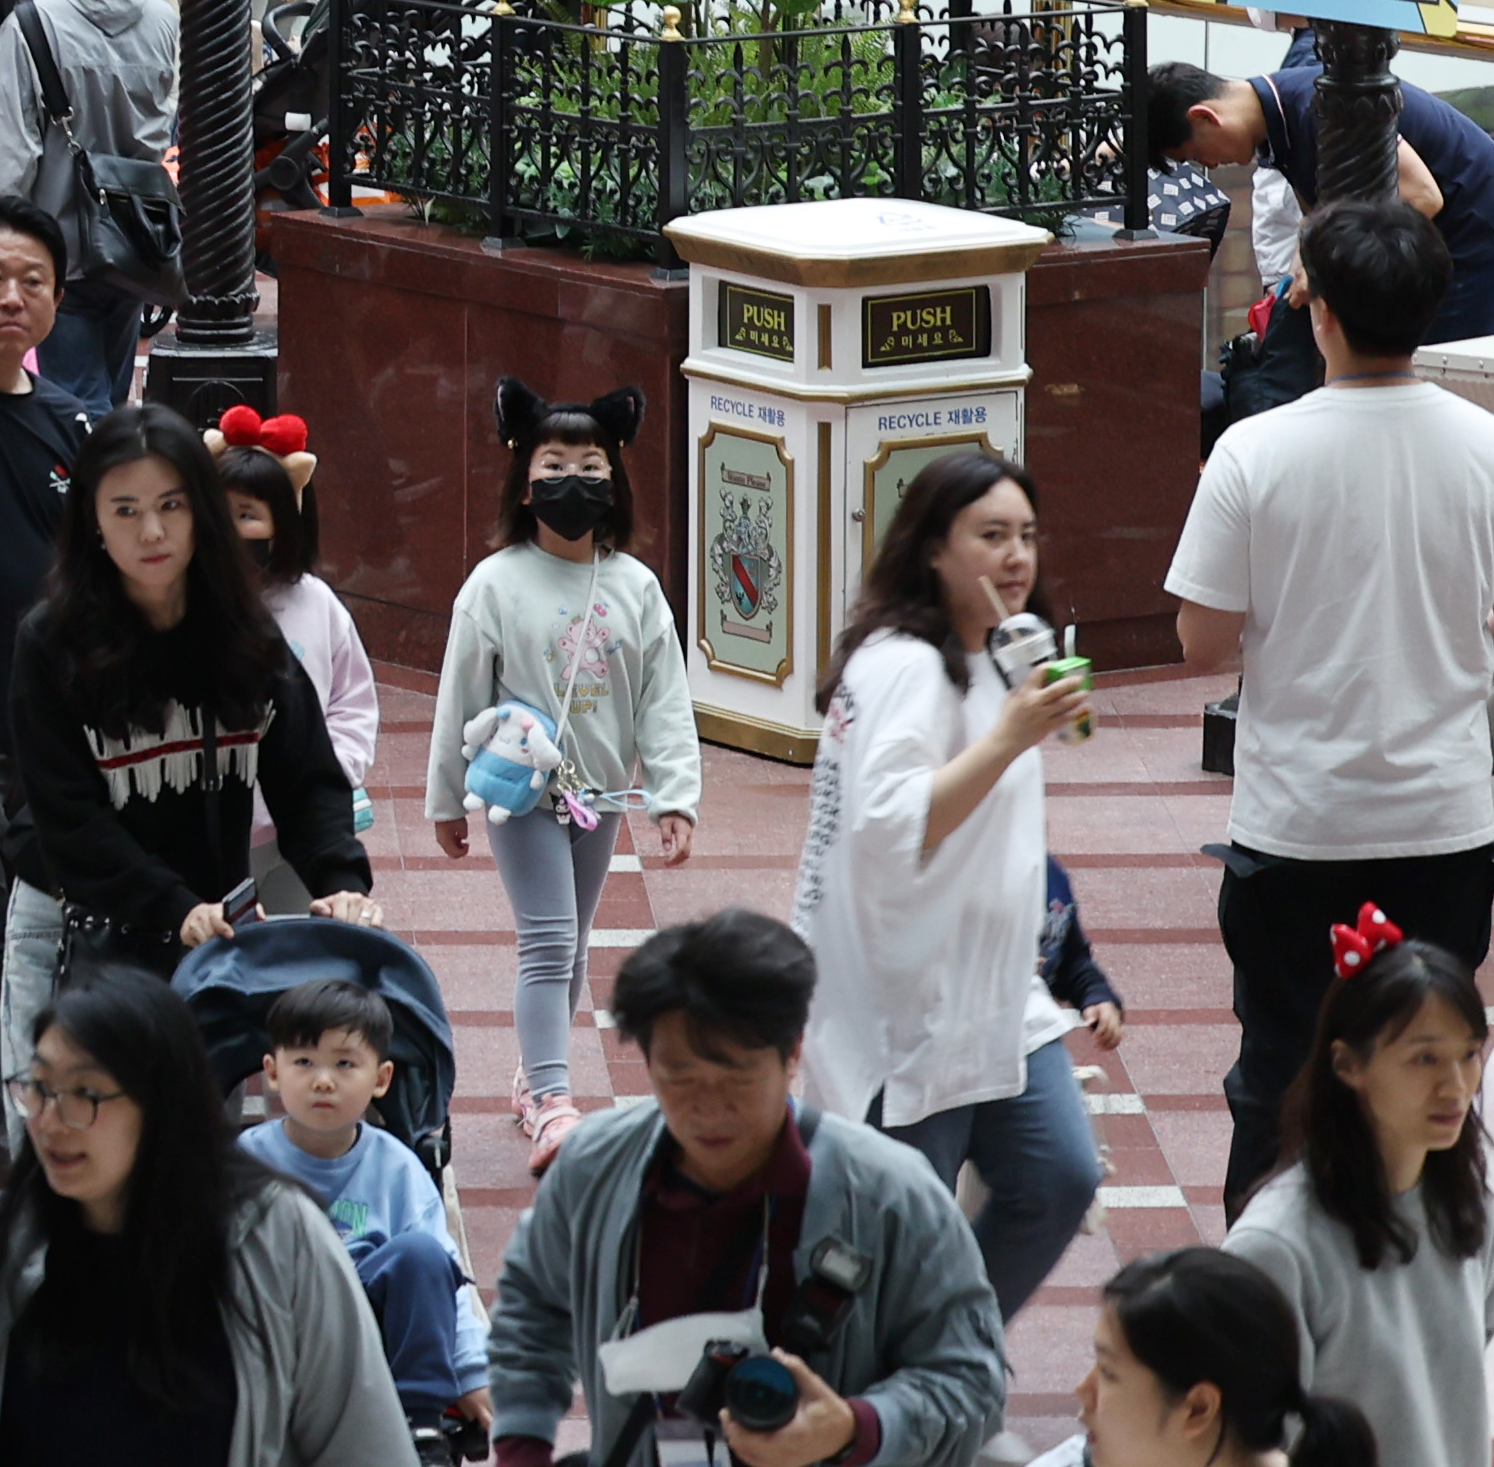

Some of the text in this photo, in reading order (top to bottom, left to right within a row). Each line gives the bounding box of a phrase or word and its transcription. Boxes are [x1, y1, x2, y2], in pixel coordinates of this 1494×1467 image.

[742, 303, 786, 331] PUSH
[891, 305, 952, 332] PUSH
[901, 329, 944, 348] 미세요
[710, 395, 786, 428] RECYCLE 재활용
[878, 405, 988, 432] RECYCLE 재활용
